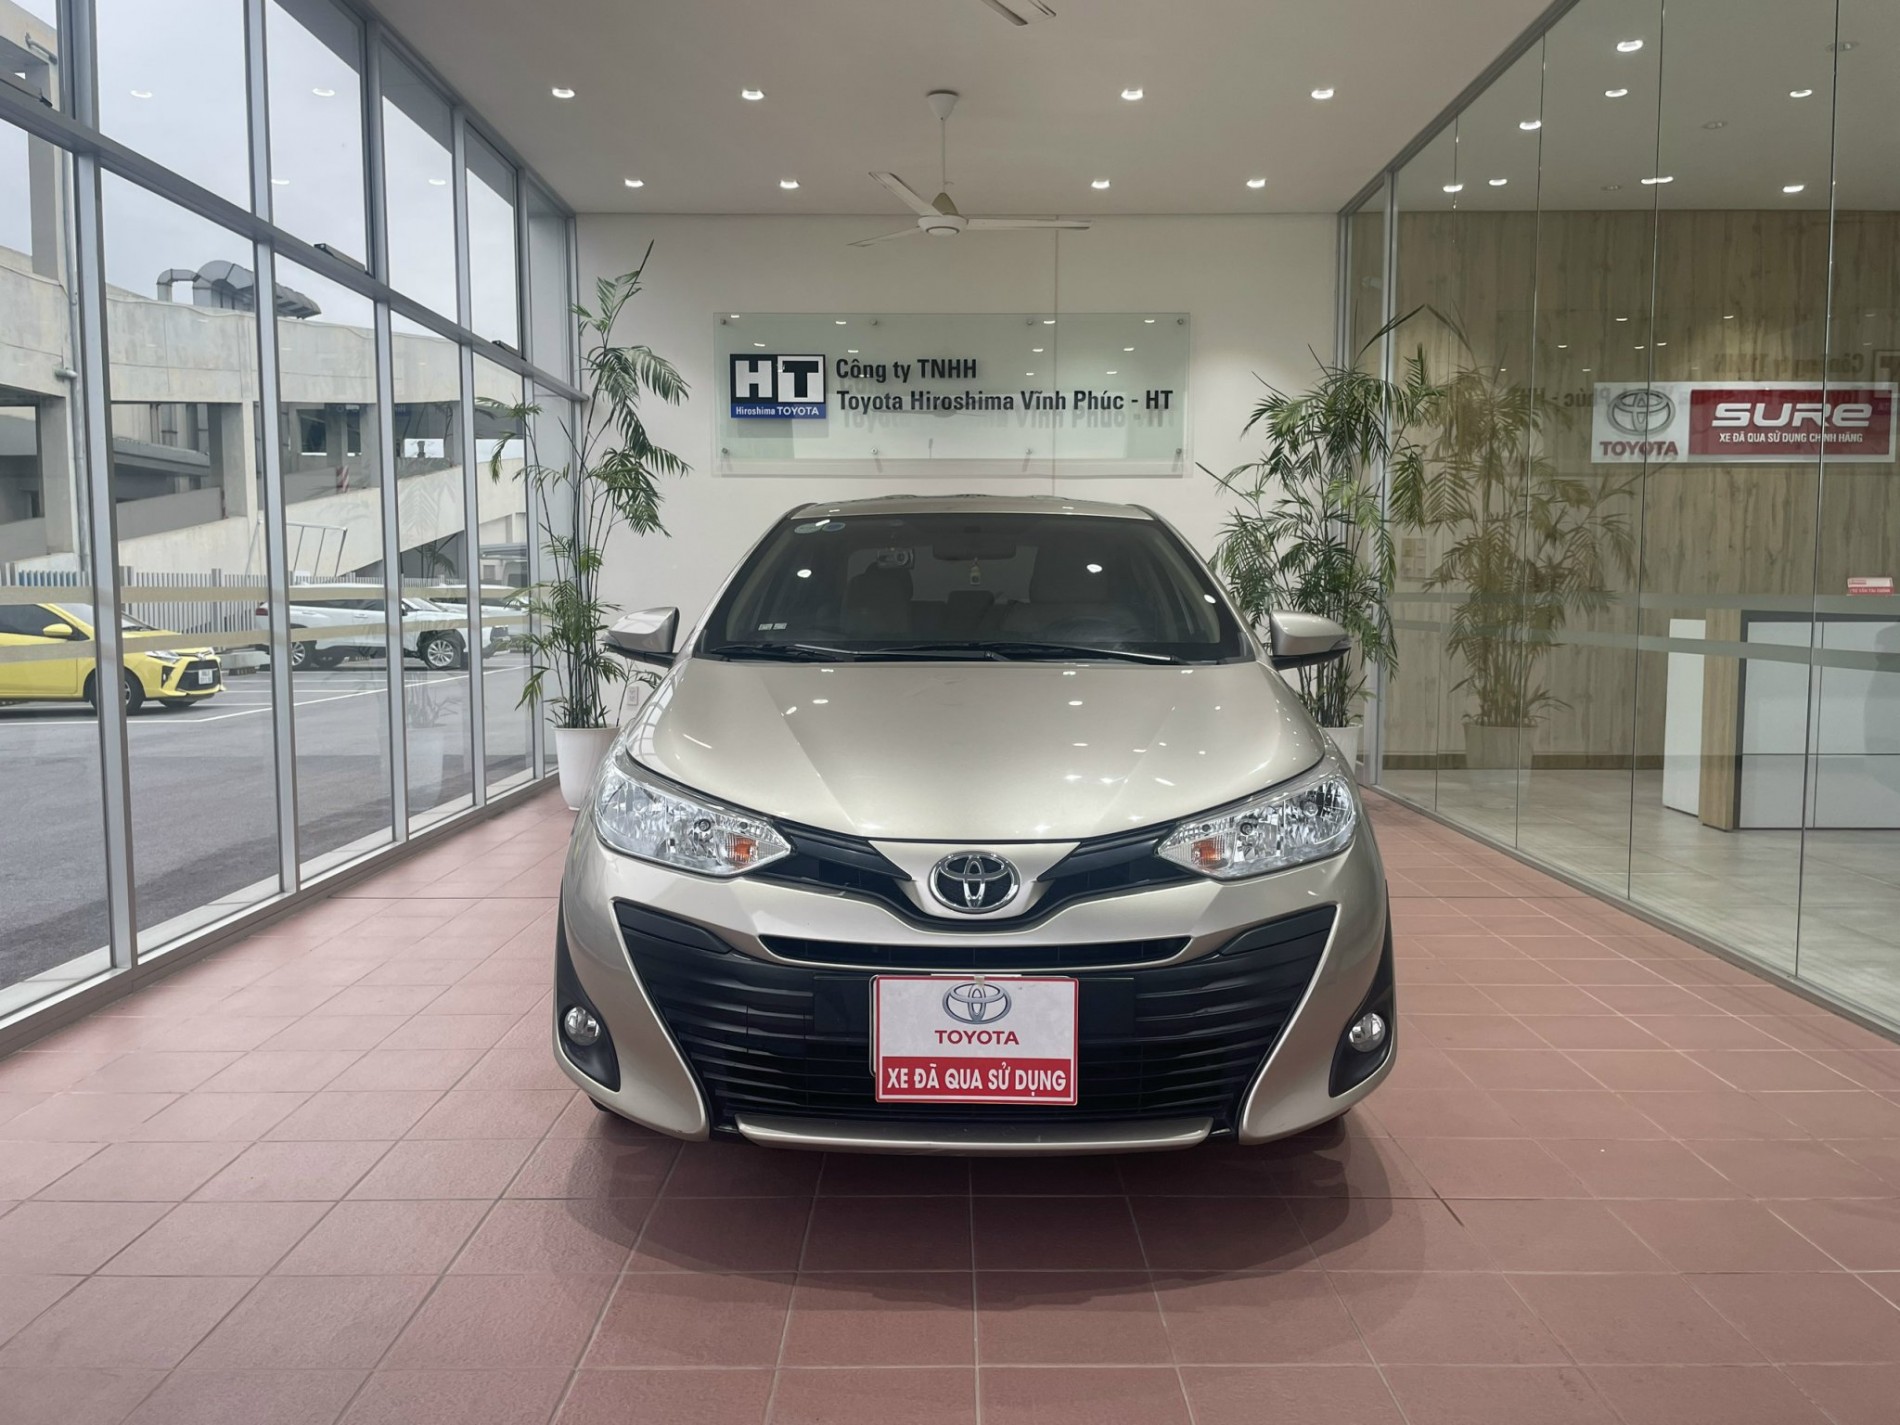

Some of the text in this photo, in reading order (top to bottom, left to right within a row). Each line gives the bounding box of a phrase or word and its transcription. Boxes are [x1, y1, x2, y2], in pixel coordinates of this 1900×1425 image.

[836, 358, 977, 383] Công ty TNHH
[836, 390, 903, 415] Toyota
[911, 390, 1014, 410] Hiroshima
[1020, 390, 1066, 410] Vĩnh
[1073, 390, 1124, 410] Phúc
[1145, 390, 1174, 410] HT
[736, 406, 819, 416] Hiroshima TOYOTA
[1719, 432, 1731, 443] XE
[1732, 430, 1745, 443] ĐÃ
[1747, 432, 1766, 443] QUA
[1767, 429, 1781, 443] SỬ
[1782, 432, 1807, 444] DỤNG
[1809, 432, 1837, 443] CHNH
[1599, 441, 1679, 456] TOYOTA
[934, 1030, 1020, 1045] TOYOTA
[887, 1061, 1067, 1097] XE ĐÃ QUA SỬ DỤNG
